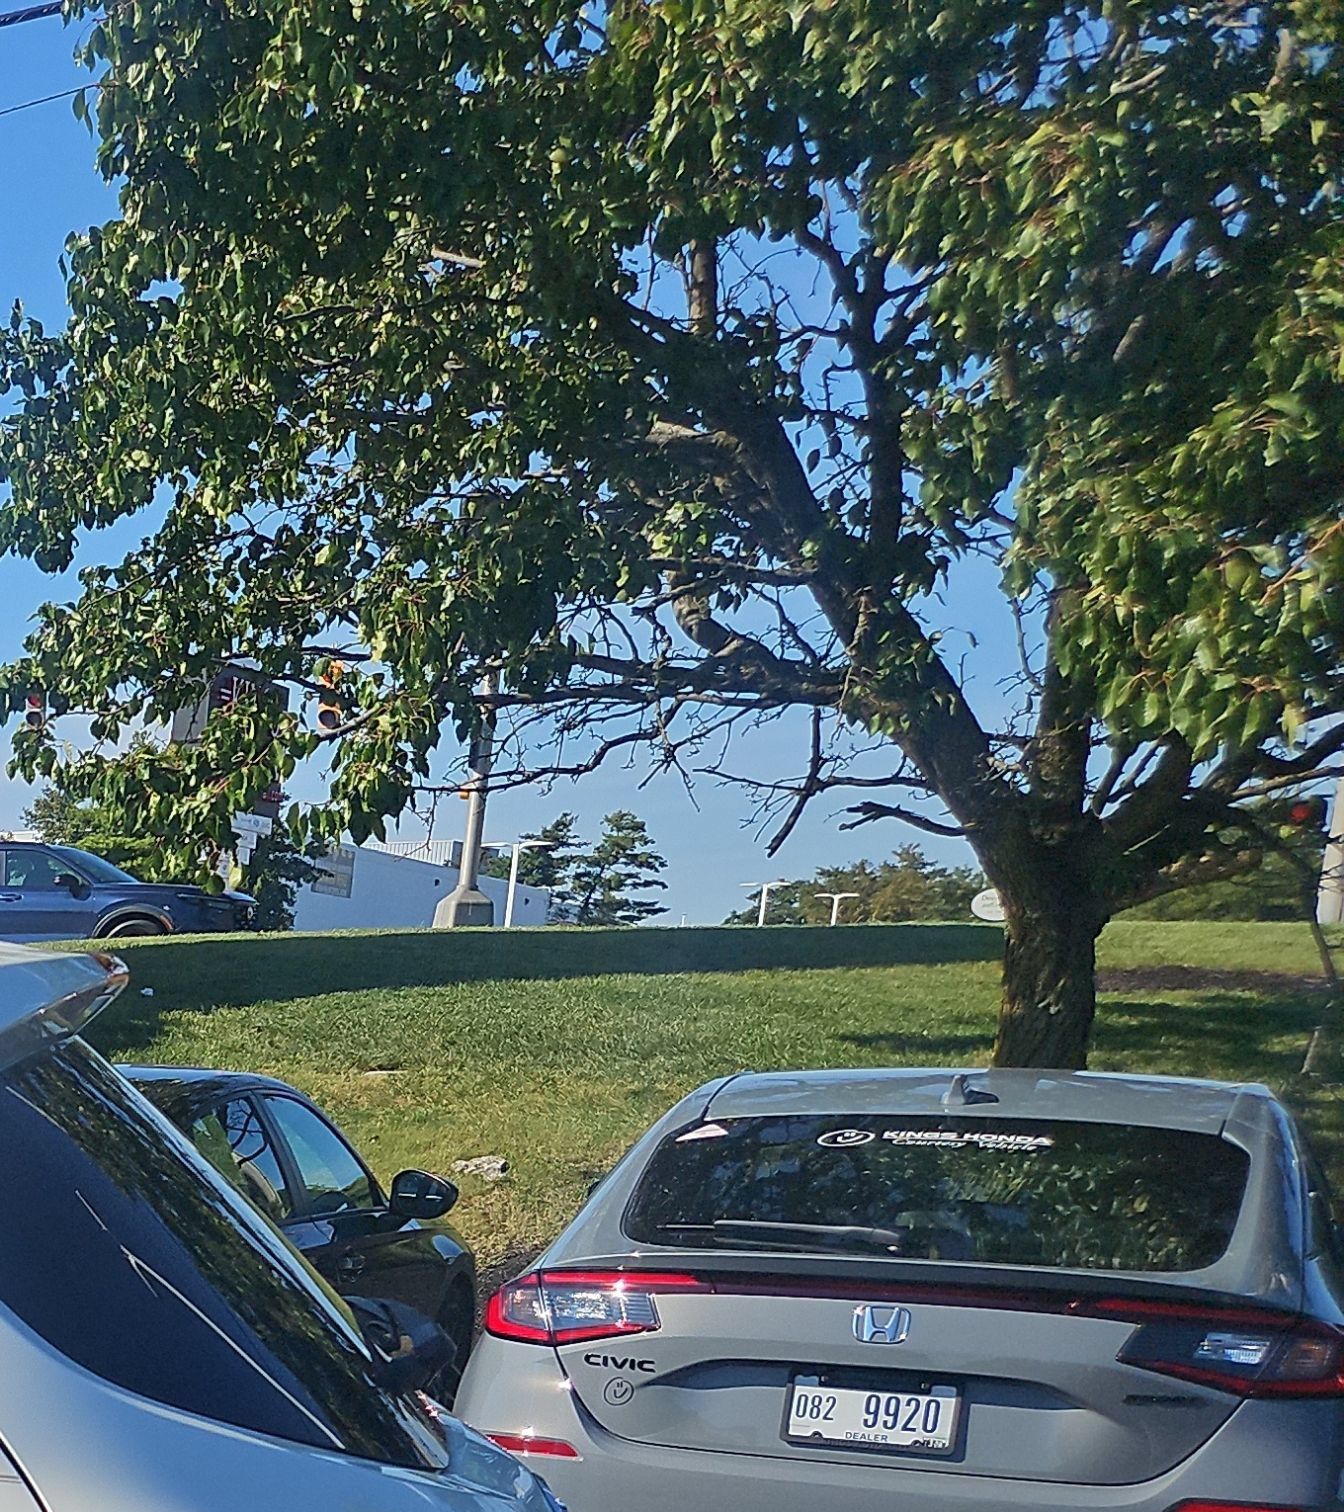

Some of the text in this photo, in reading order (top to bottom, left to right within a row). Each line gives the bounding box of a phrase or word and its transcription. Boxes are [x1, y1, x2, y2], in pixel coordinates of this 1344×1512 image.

[882, 1130, 1054, 1146] KINGS HONDA
[583, 1353, 657, 1374] CIVIC
[795, 1393, 941, 1434] 082 9920
[844, 1431, 889, 1443] DEALER
